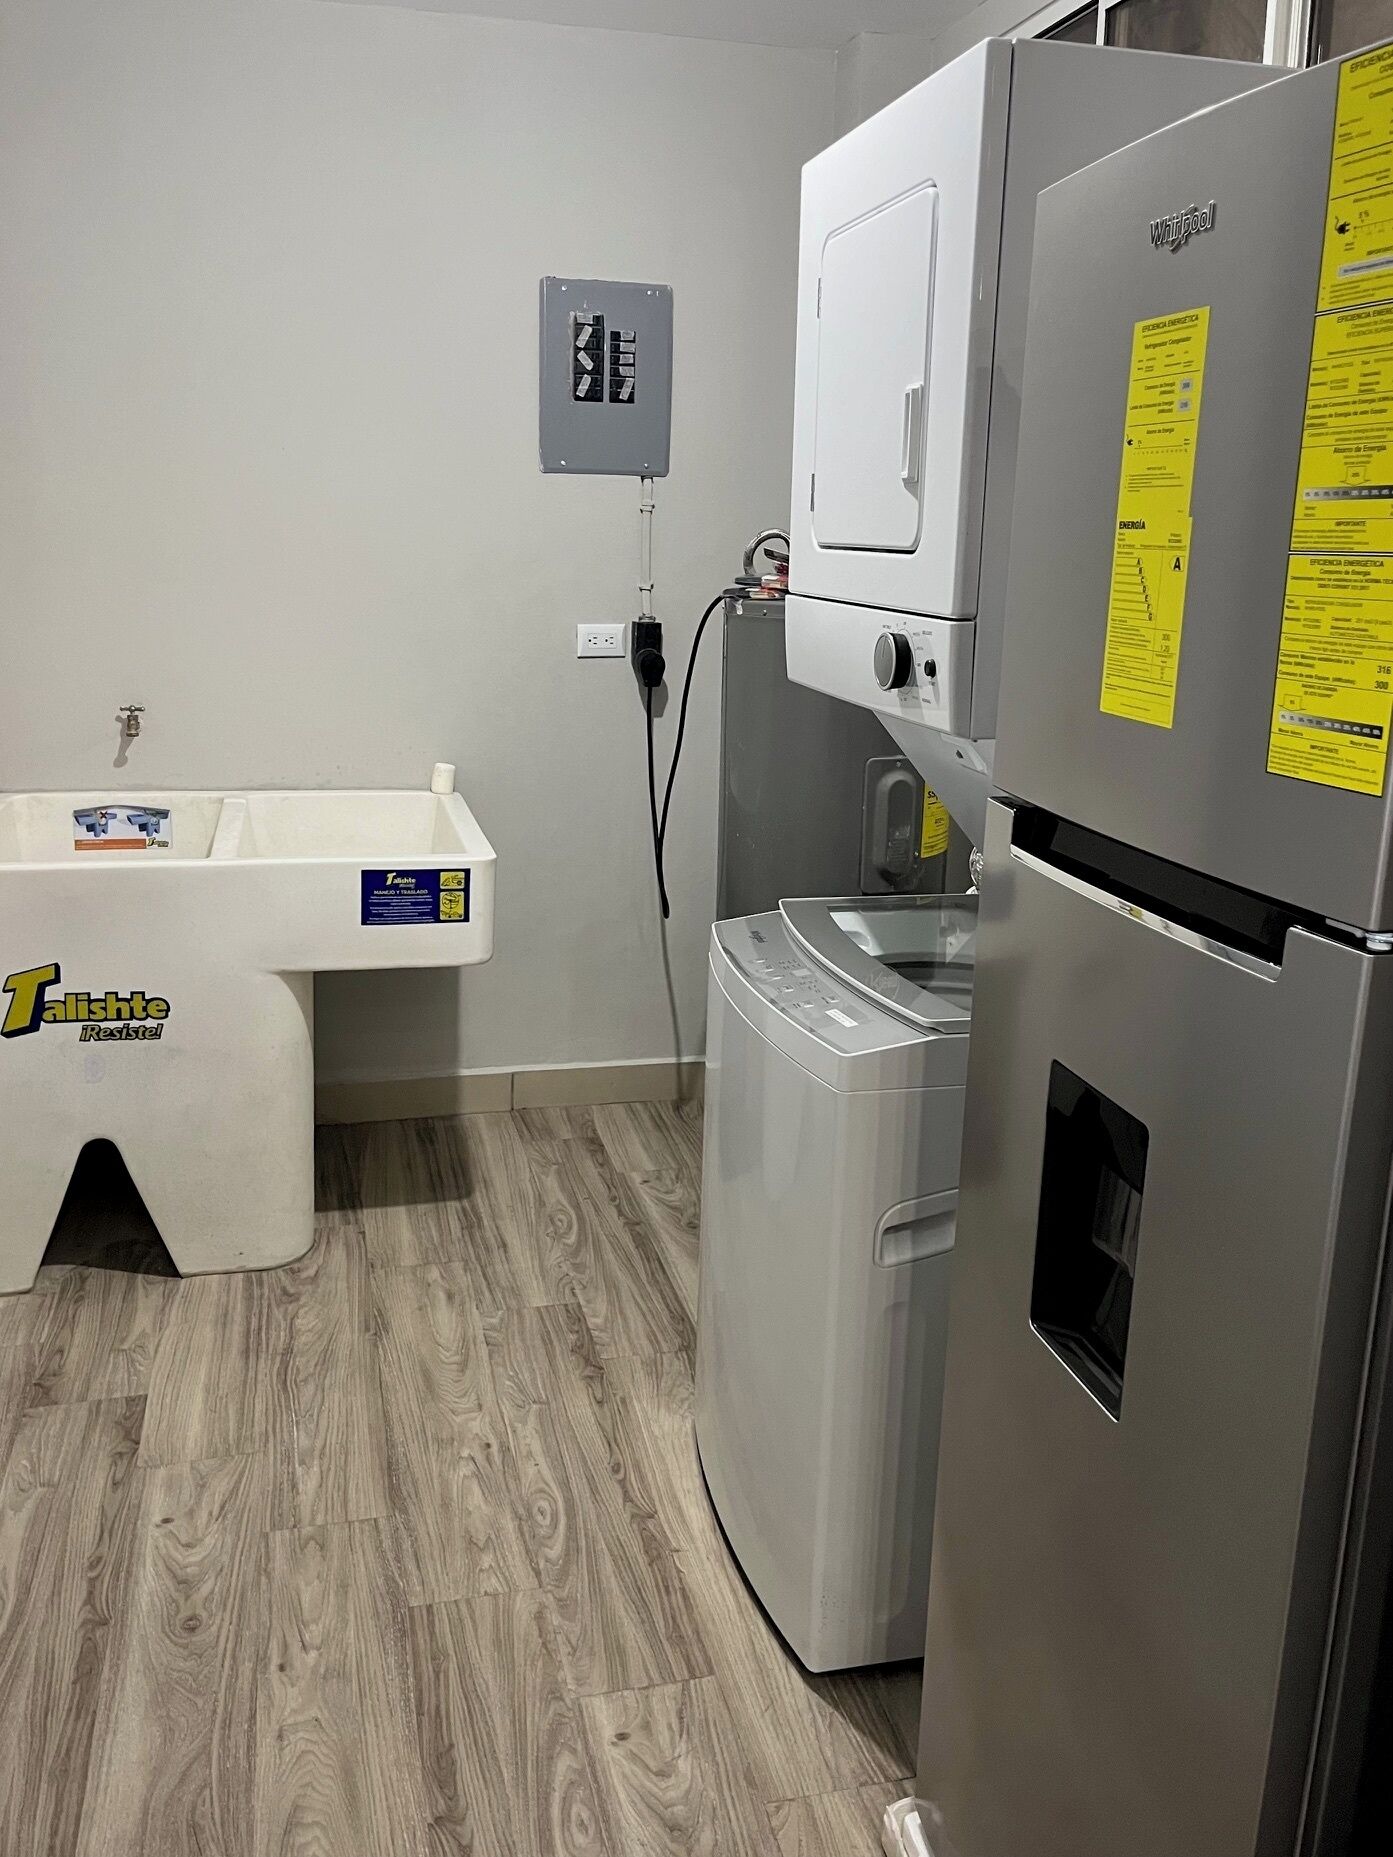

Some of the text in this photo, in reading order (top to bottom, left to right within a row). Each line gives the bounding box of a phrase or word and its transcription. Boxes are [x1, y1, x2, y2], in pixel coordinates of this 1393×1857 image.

[1149, 199, 1216, 251] Whirlpool
[1118, 518, 1146, 530] ENERGÍA
[1173, 556, 1182, 571] A
[386, 872, 416, 885] Talishte
[1, 962, 171, 1038] Talishte
[79, 1022, 164, 1042] ¡Resiste!
